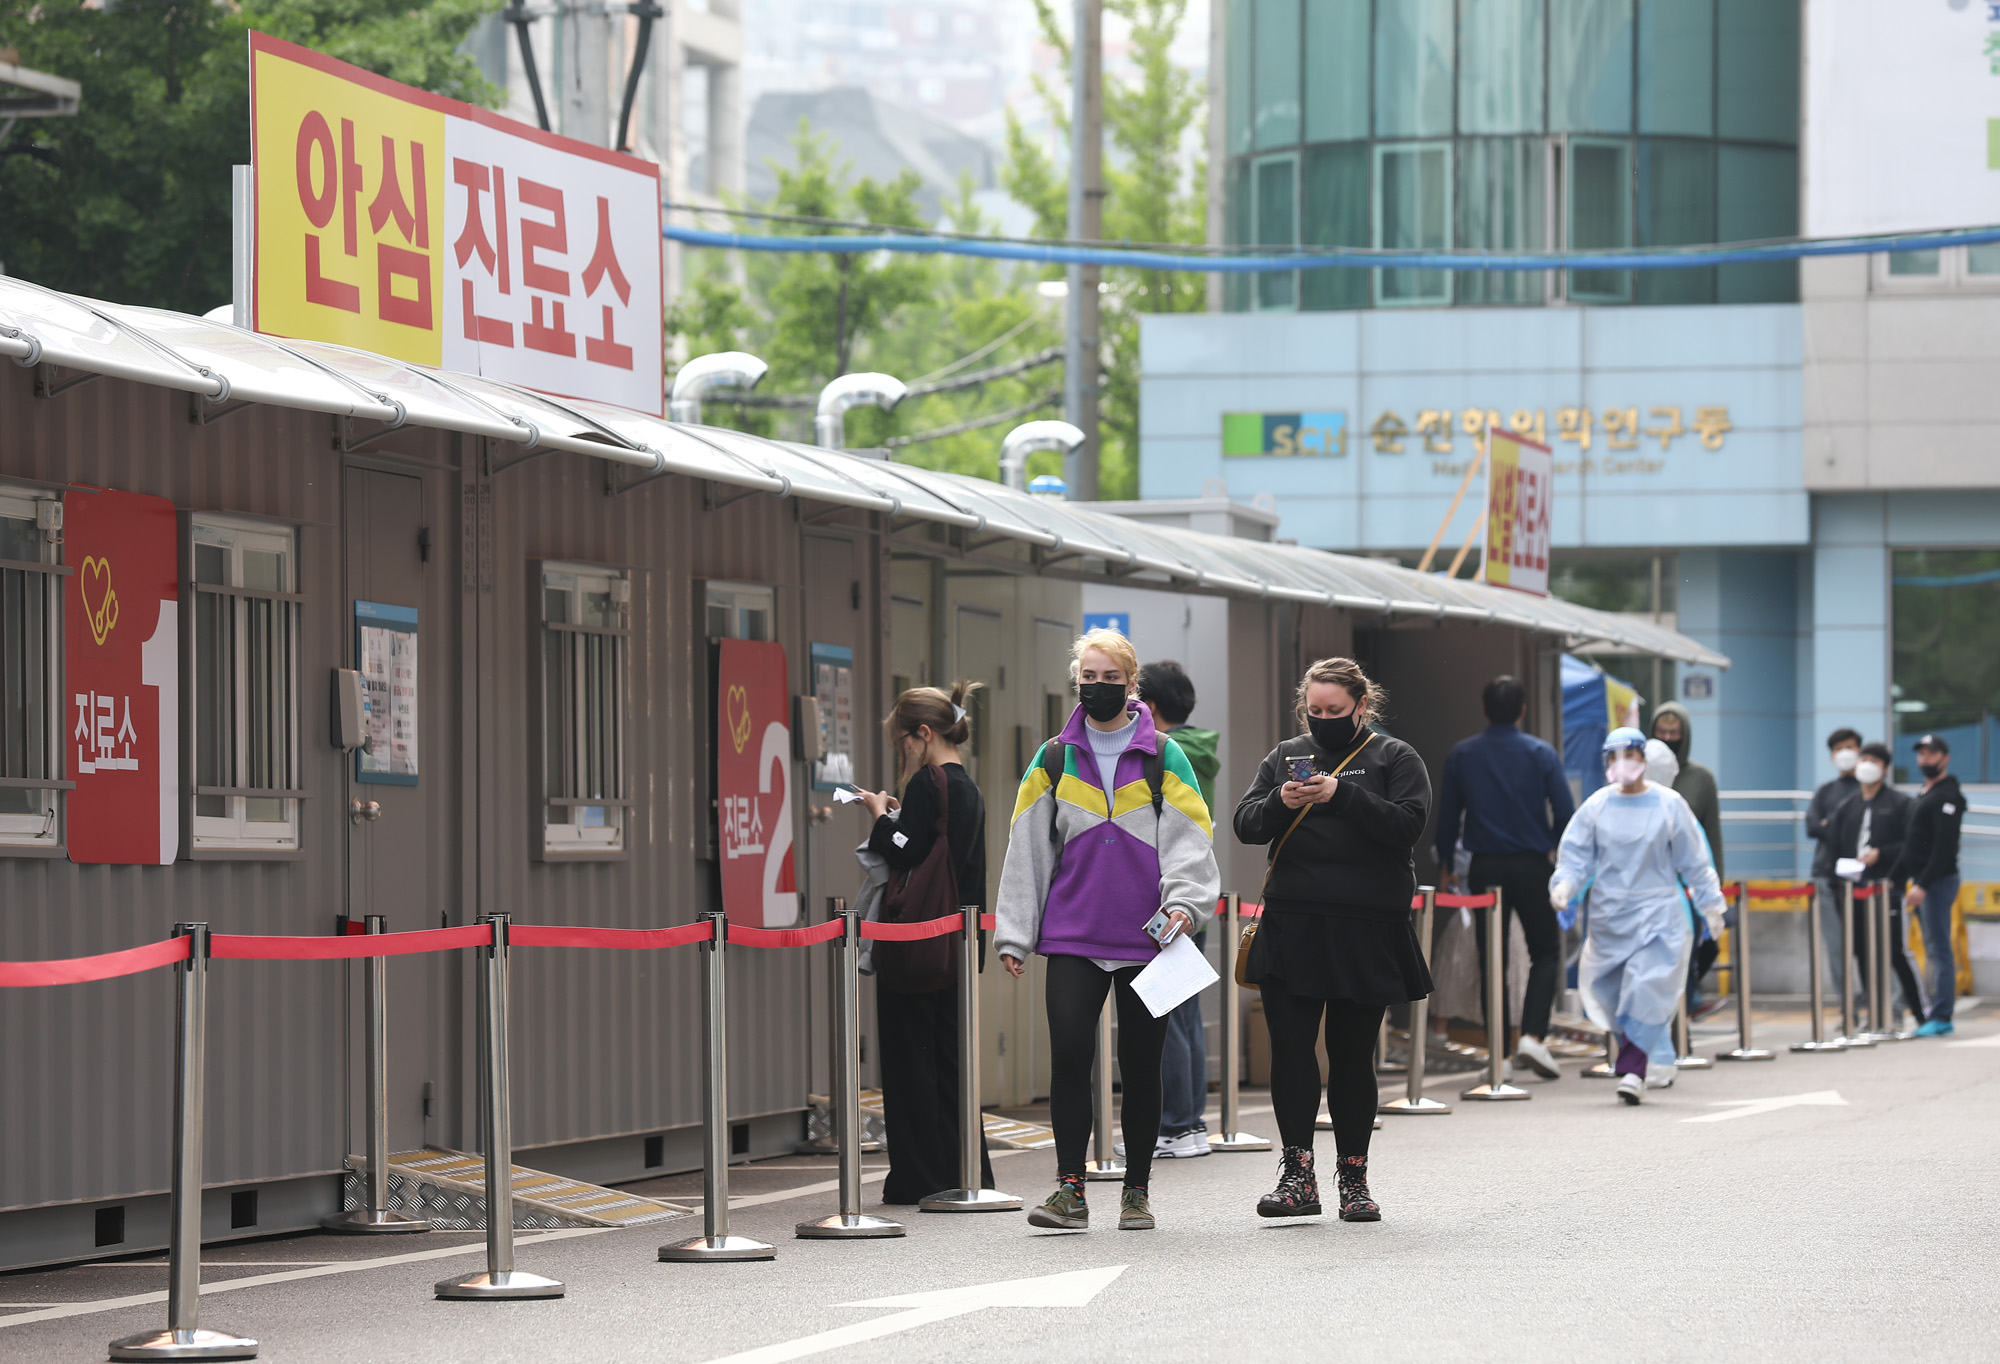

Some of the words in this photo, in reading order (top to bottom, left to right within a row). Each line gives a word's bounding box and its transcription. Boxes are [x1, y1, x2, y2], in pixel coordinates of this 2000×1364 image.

[296, 110, 434, 331] 안심
[453, 157, 634, 371] 진료소
[1272, 425, 1346, 457] SCH
[1602, 455, 1665, 477] Center
[1514, 468, 1550, 571] 진료소
[75, 690, 139, 774] 진료소
[724, 794, 765, 860] 진료소
[758, 721, 799, 928] 2
